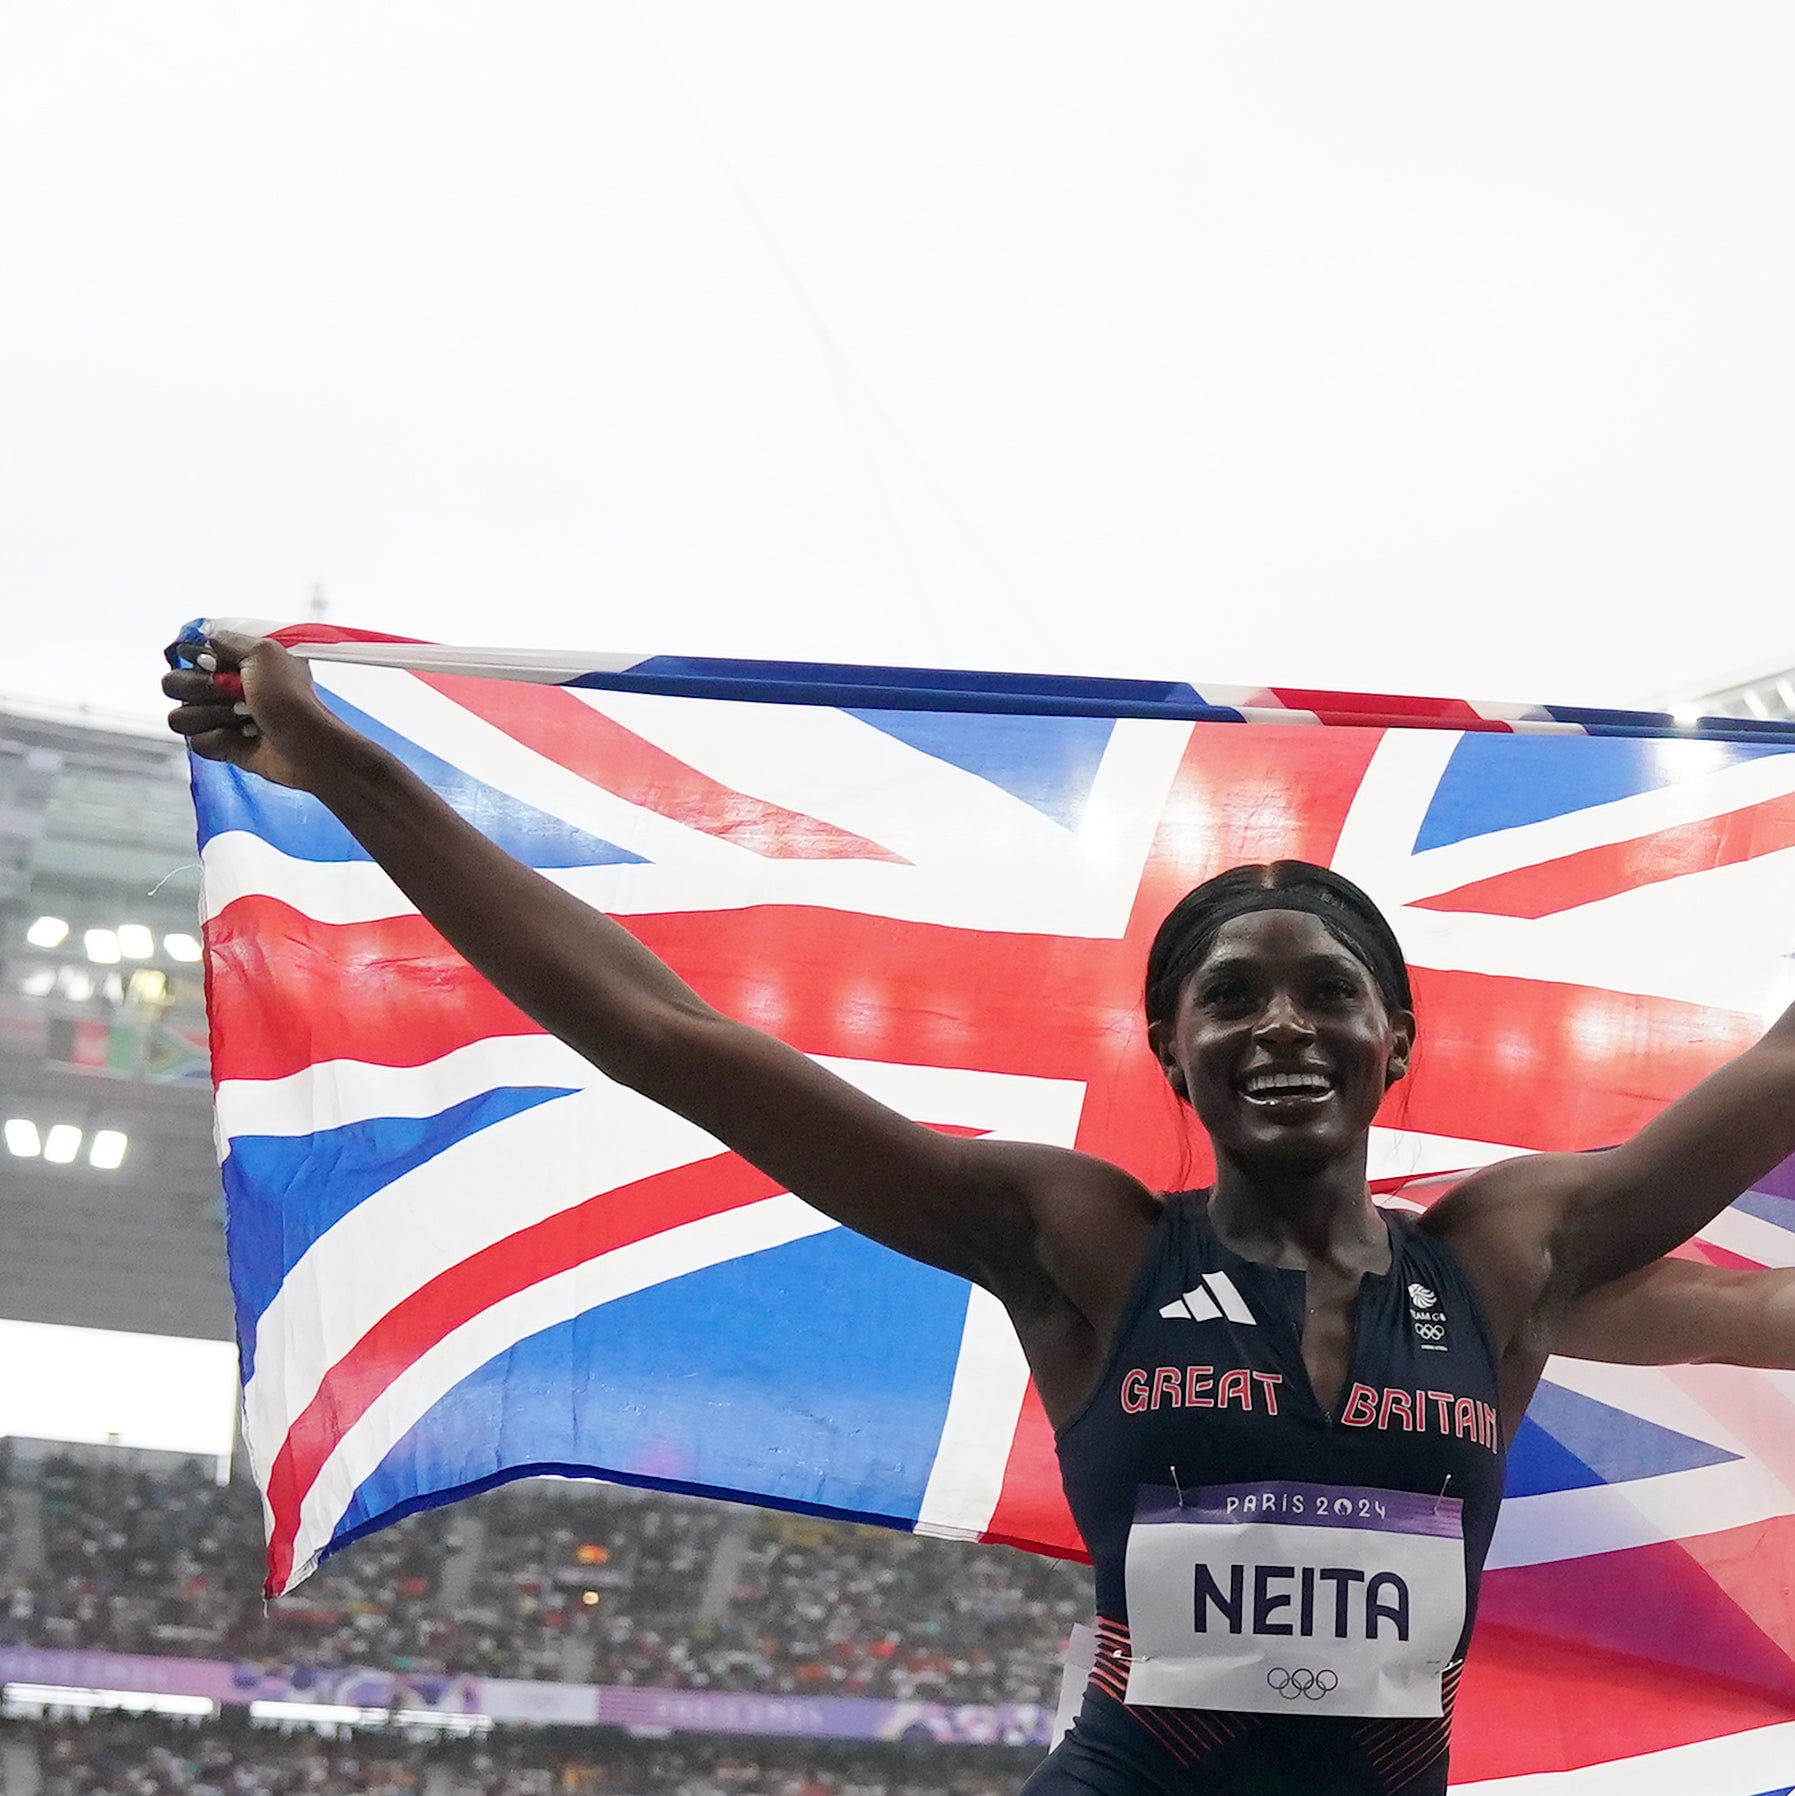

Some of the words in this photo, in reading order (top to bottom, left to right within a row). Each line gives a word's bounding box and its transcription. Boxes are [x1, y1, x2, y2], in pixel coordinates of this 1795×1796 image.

[1121, 1365, 1283, 1416] GREAT
[1340, 1381, 1499, 1453] BRITAIN
[1225, 1492, 1305, 1514] PARIS
[1315, 1494, 1388, 1520] 2024
[1192, 1564, 1411, 1642] NEITA
